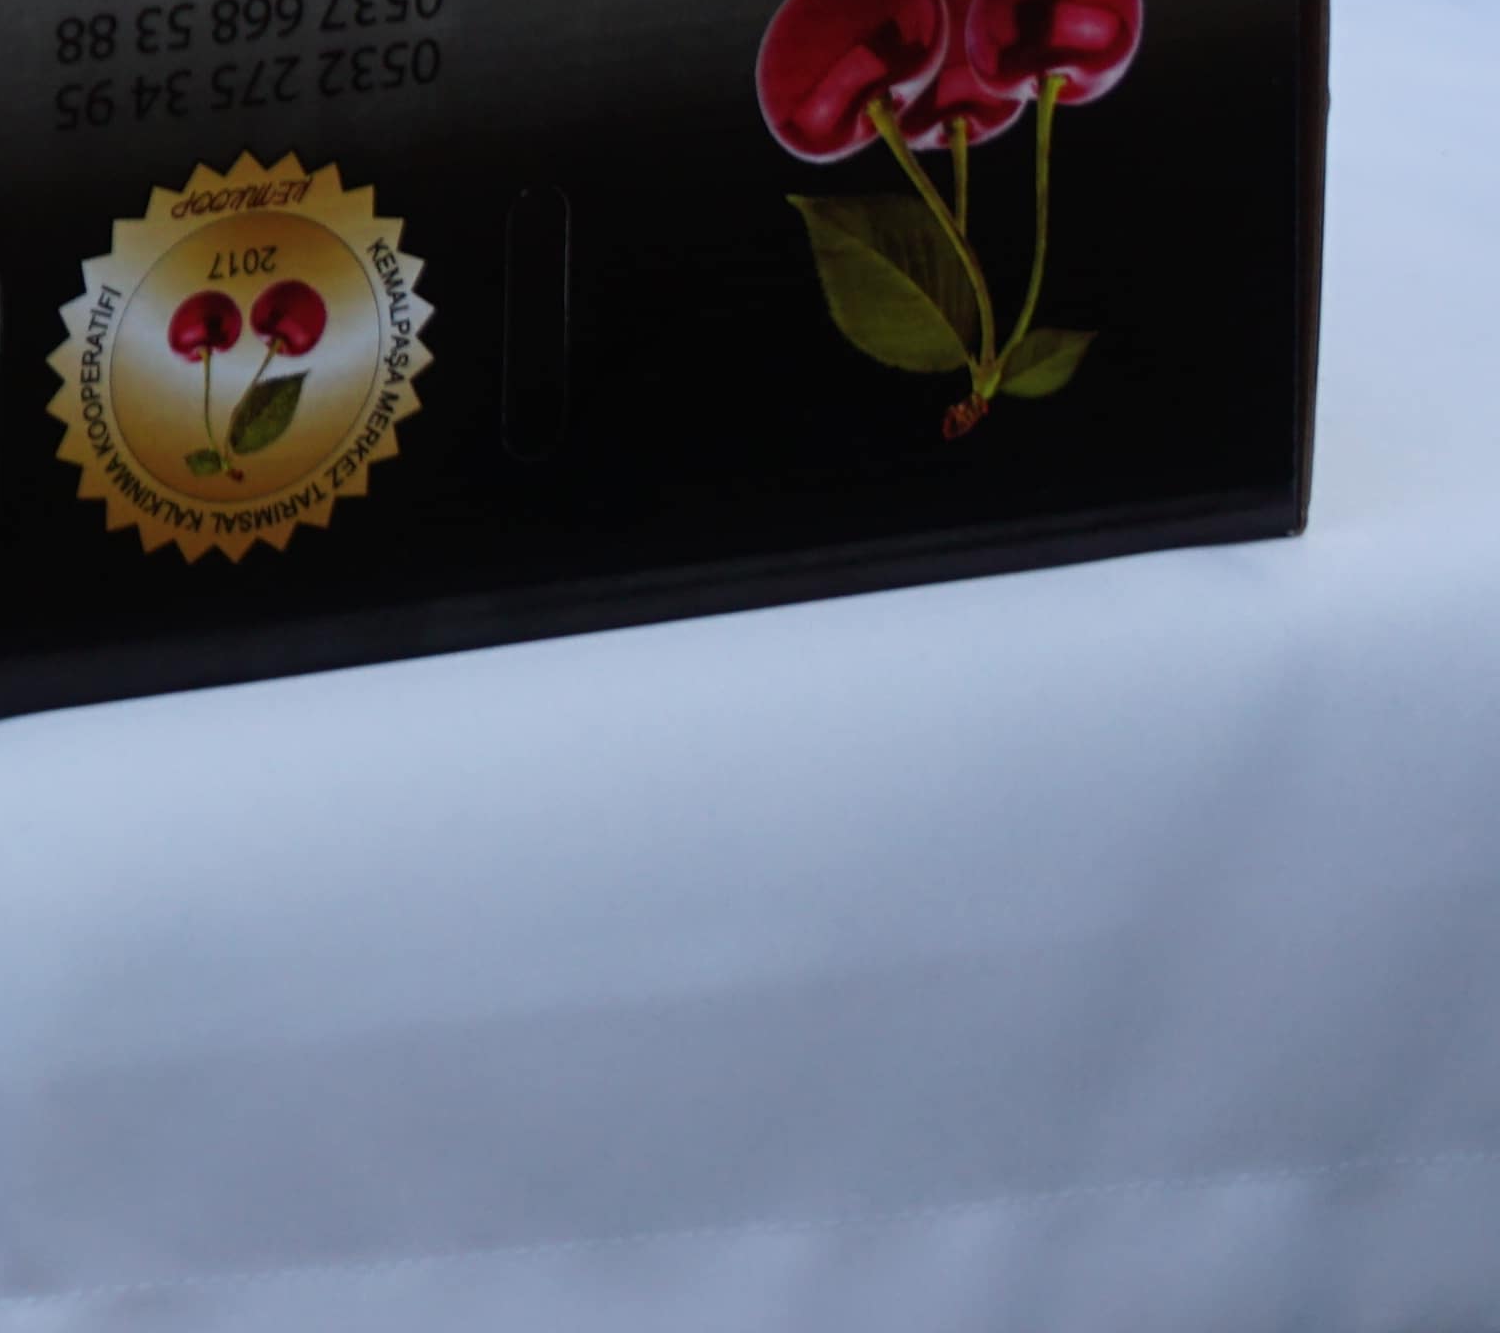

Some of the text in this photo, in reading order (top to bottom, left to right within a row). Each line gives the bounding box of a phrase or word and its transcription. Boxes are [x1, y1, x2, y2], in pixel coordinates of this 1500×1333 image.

[55, 12, 117, 64] 88
[136, 3, 194, 55] 53
[54, 39, 441, 130] 0532 275 34 95
[208, 246, 277, 277] 2017
[367, 238, 410, 401] KEMALPAŞA
[326, 385, 397, 486] MERKEZ
[105, 450, 202, 530] KALKINMA
[211, 480, 326, 533] TARIMSAL
